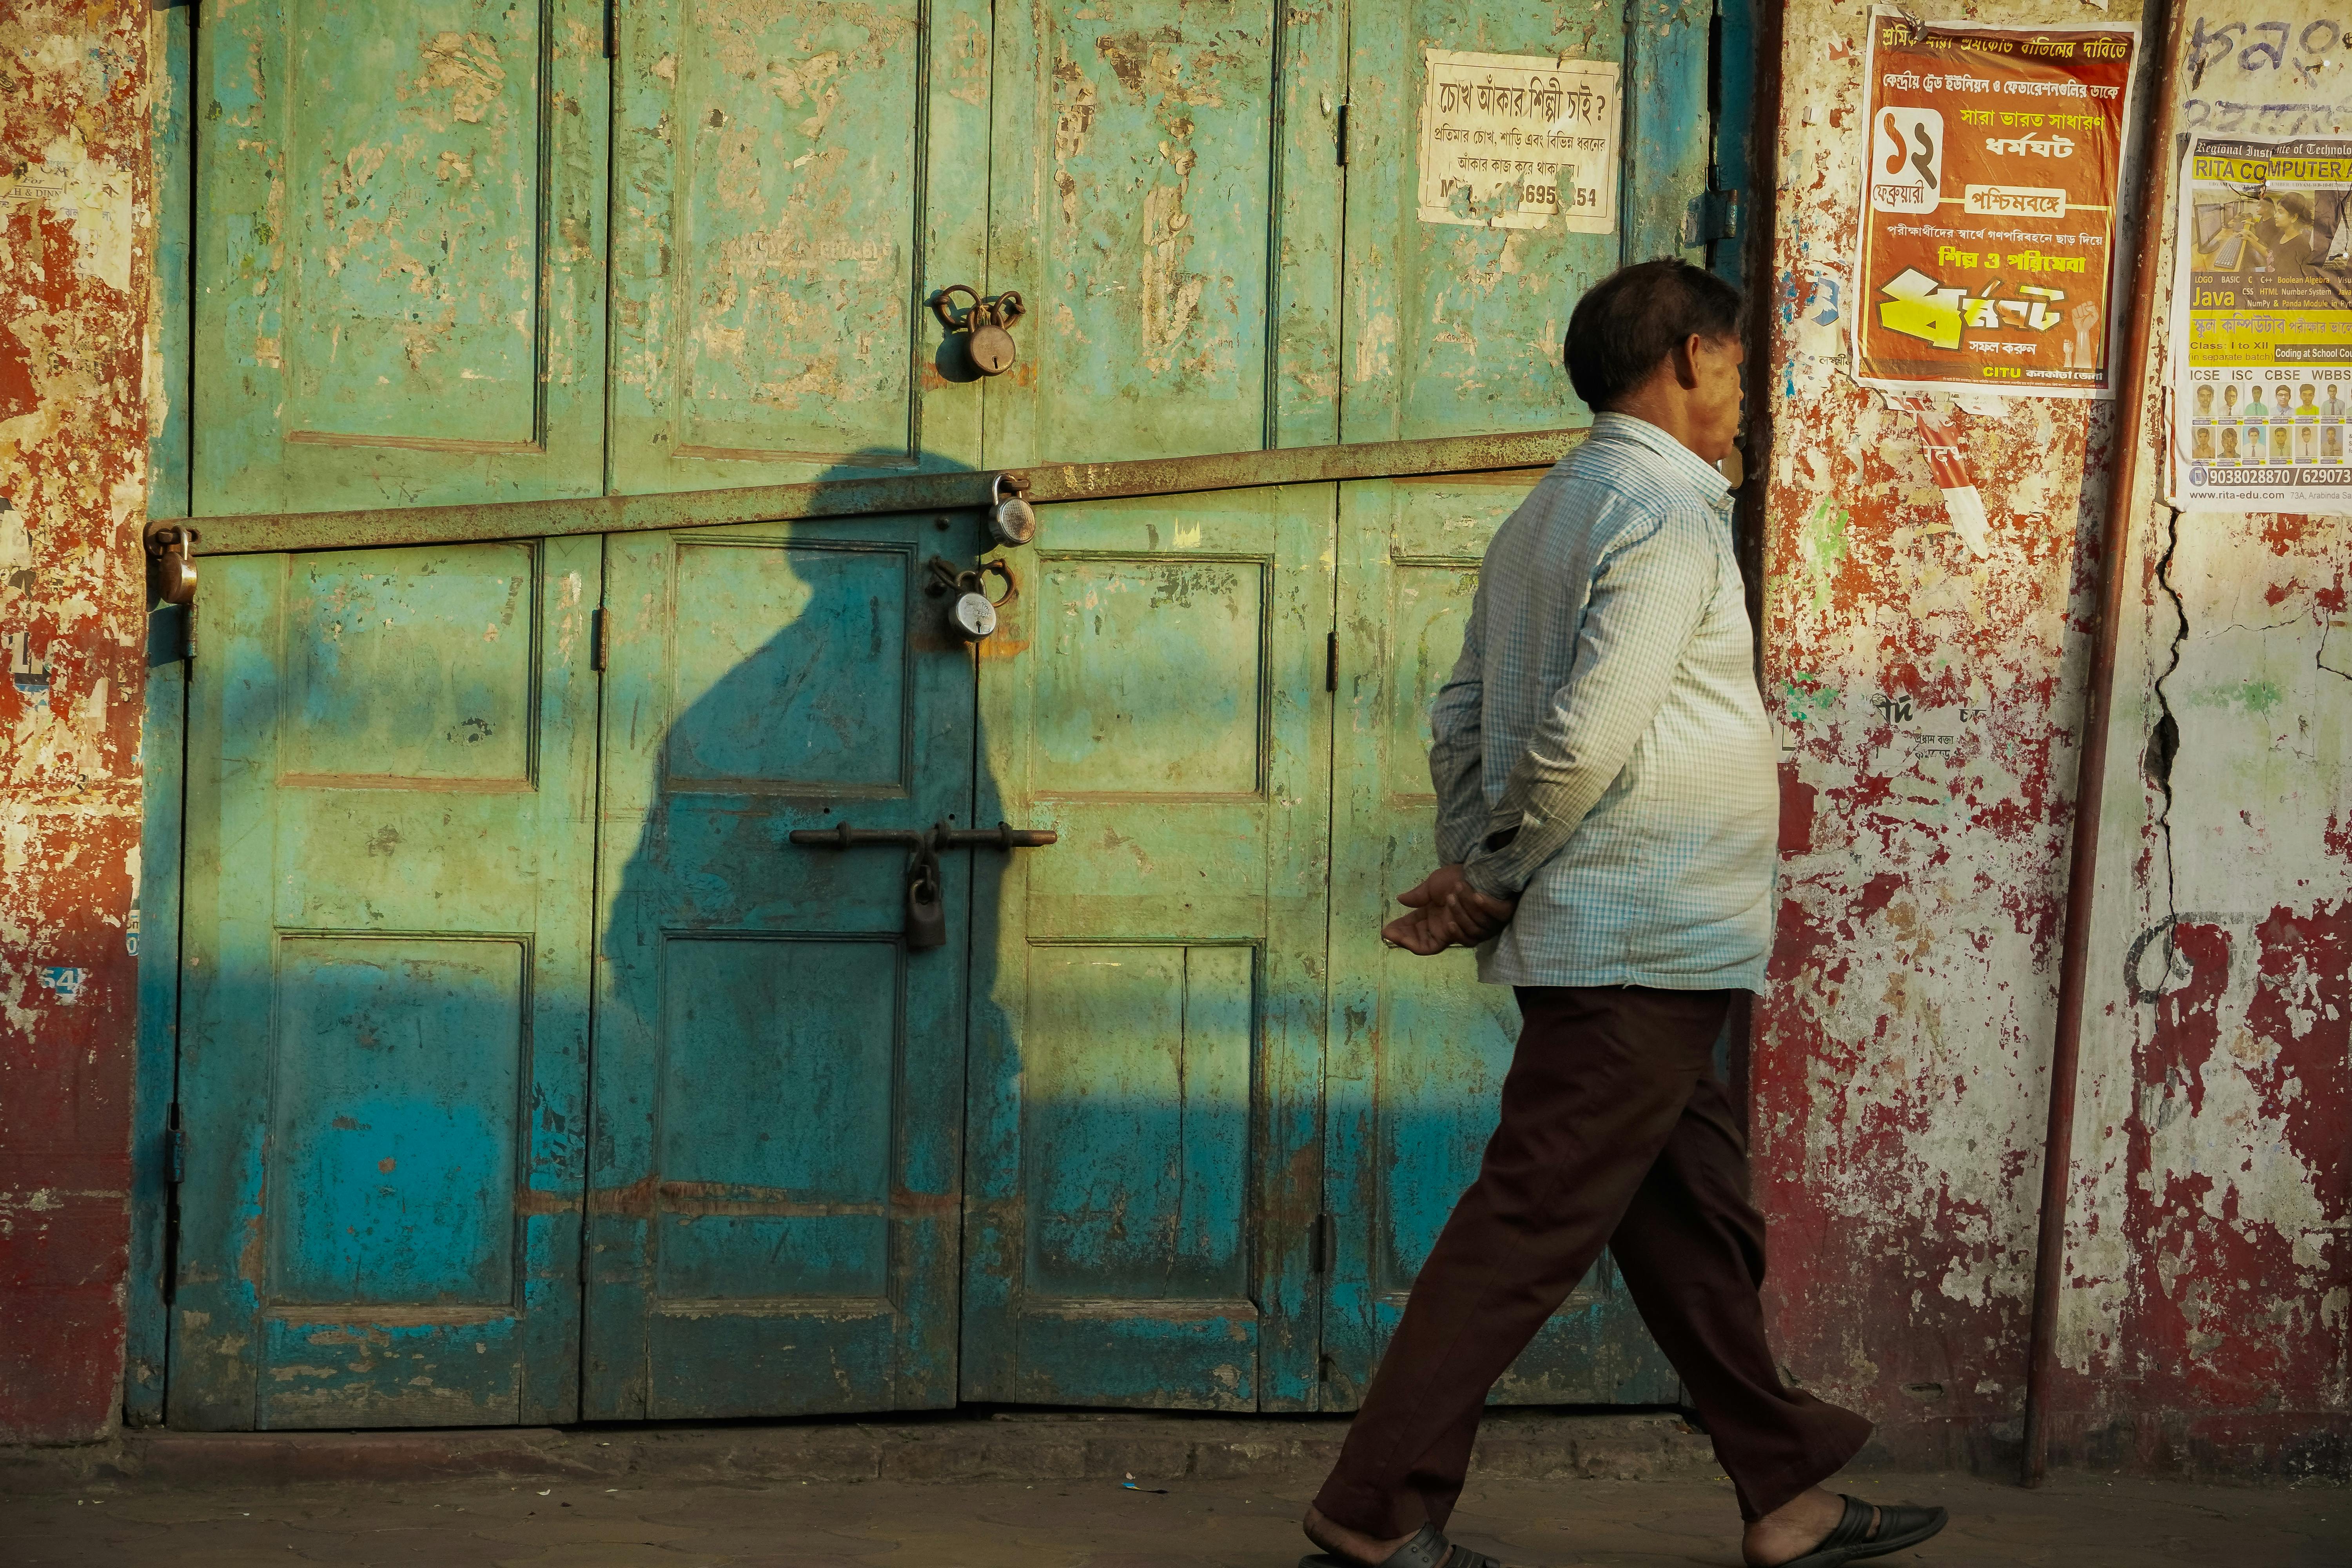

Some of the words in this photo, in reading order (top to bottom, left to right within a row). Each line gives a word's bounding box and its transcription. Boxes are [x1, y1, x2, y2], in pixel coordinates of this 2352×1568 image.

[2083, 37, 2128, 58] দাবিতে
[1883, 70, 1920, 91] কেন্দ্রীয়
[1923, 73, 1943, 93] ট্রেড
[1944, 73, 1990, 93] ইউনিয়ন
[1993, 80, 2000, 92] ও
[2090, 85, 2120, 100] ডাকে
[1439, 79, 1474, 114] চোখ
[1477, 74, 1525, 118] আঁকার
[1529, 76, 1563, 123] শিল্পী
[1960, 109, 1994, 127] সারা
[1999, 111, 2045, 128] ভারত
[2049, 113, 2105, 132] সাধারণ
[1434, 123, 1469, 144] প্রতিমার
[1474, 131, 1497, 147] চোখ,
[1500, 127, 1522, 149] শাড়ি
[1525, 134, 1543, 149] এবং
[1546, 130, 1574, 150] বিভিন্ন
[1577, 137, 1606, 152] ধরনের
[1985, 132, 2075, 158] ধর্মঘট
[1884, 113, 1938, 190] ১২
[2195, 142, 2243, 155] Regional
[2294, 143, 2303, 154] of
[1457, 152, 1488, 172] আঁকার
[1491, 159, 1511, 174] কাজ
[2196, 160, 2234, 178] RITA
[2240, 161, 2341, 180] COMPUTER
[23, 176, 44, 185] For
[1971, 187, 2061, 214] পশ্চিমবঙ্গে
[1957, 228, 1986, 240] স্বার্থে
[1988, 230, 2052, 243] গণপরিবহনে
[2056, 233, 2075, 246] ছাড়
[2079, 232, 2103, 247] দিয়ে
[1938, 246, 1978, 269] শিল্প
[1984, 252, 2000, 269] ও
[2007, 250, 2086, 274] পরিষেবা
[2305, 276, 2330, 285] Algebra
[2193, 287, 2234, 306] Java
[2308, 288, 2331, 297] System
[2247, 300, 2270, 308] NumPy
[2192, 319, 2216, 339] স্কুল
[2220, 312, 2285, 334] কম্পিউটার
[2289, 318, 2326, 334] পরীক্ষার
[1969, 341, 1999, 354] সফল
[2002, 342, 2036, 356] করুন
[2188, 353, 2199, 362] (in
[2246, 353, 2273, 362] batch)
[2276, 348, 2301, 360] Coding
[2303, 348, 2310, 358] at
[2312, 348, 2337, 358] School
[1983, 367, 2021, 378] CITU
[2025, 370, 2072, 380] কলকাতা
[2074, 371, 2102, 381] জেলা
[2190, 370, 2220, 380] ICSE
[2232, 370, 2253, 380] ISC
[2265, 370, 2300, 380] CBSE
[2210, 470, 2290, 484] 9038028870
[2293, 468, 2300, 486] /
[2190, 491, 2284, 499] www.rita-edu.com
